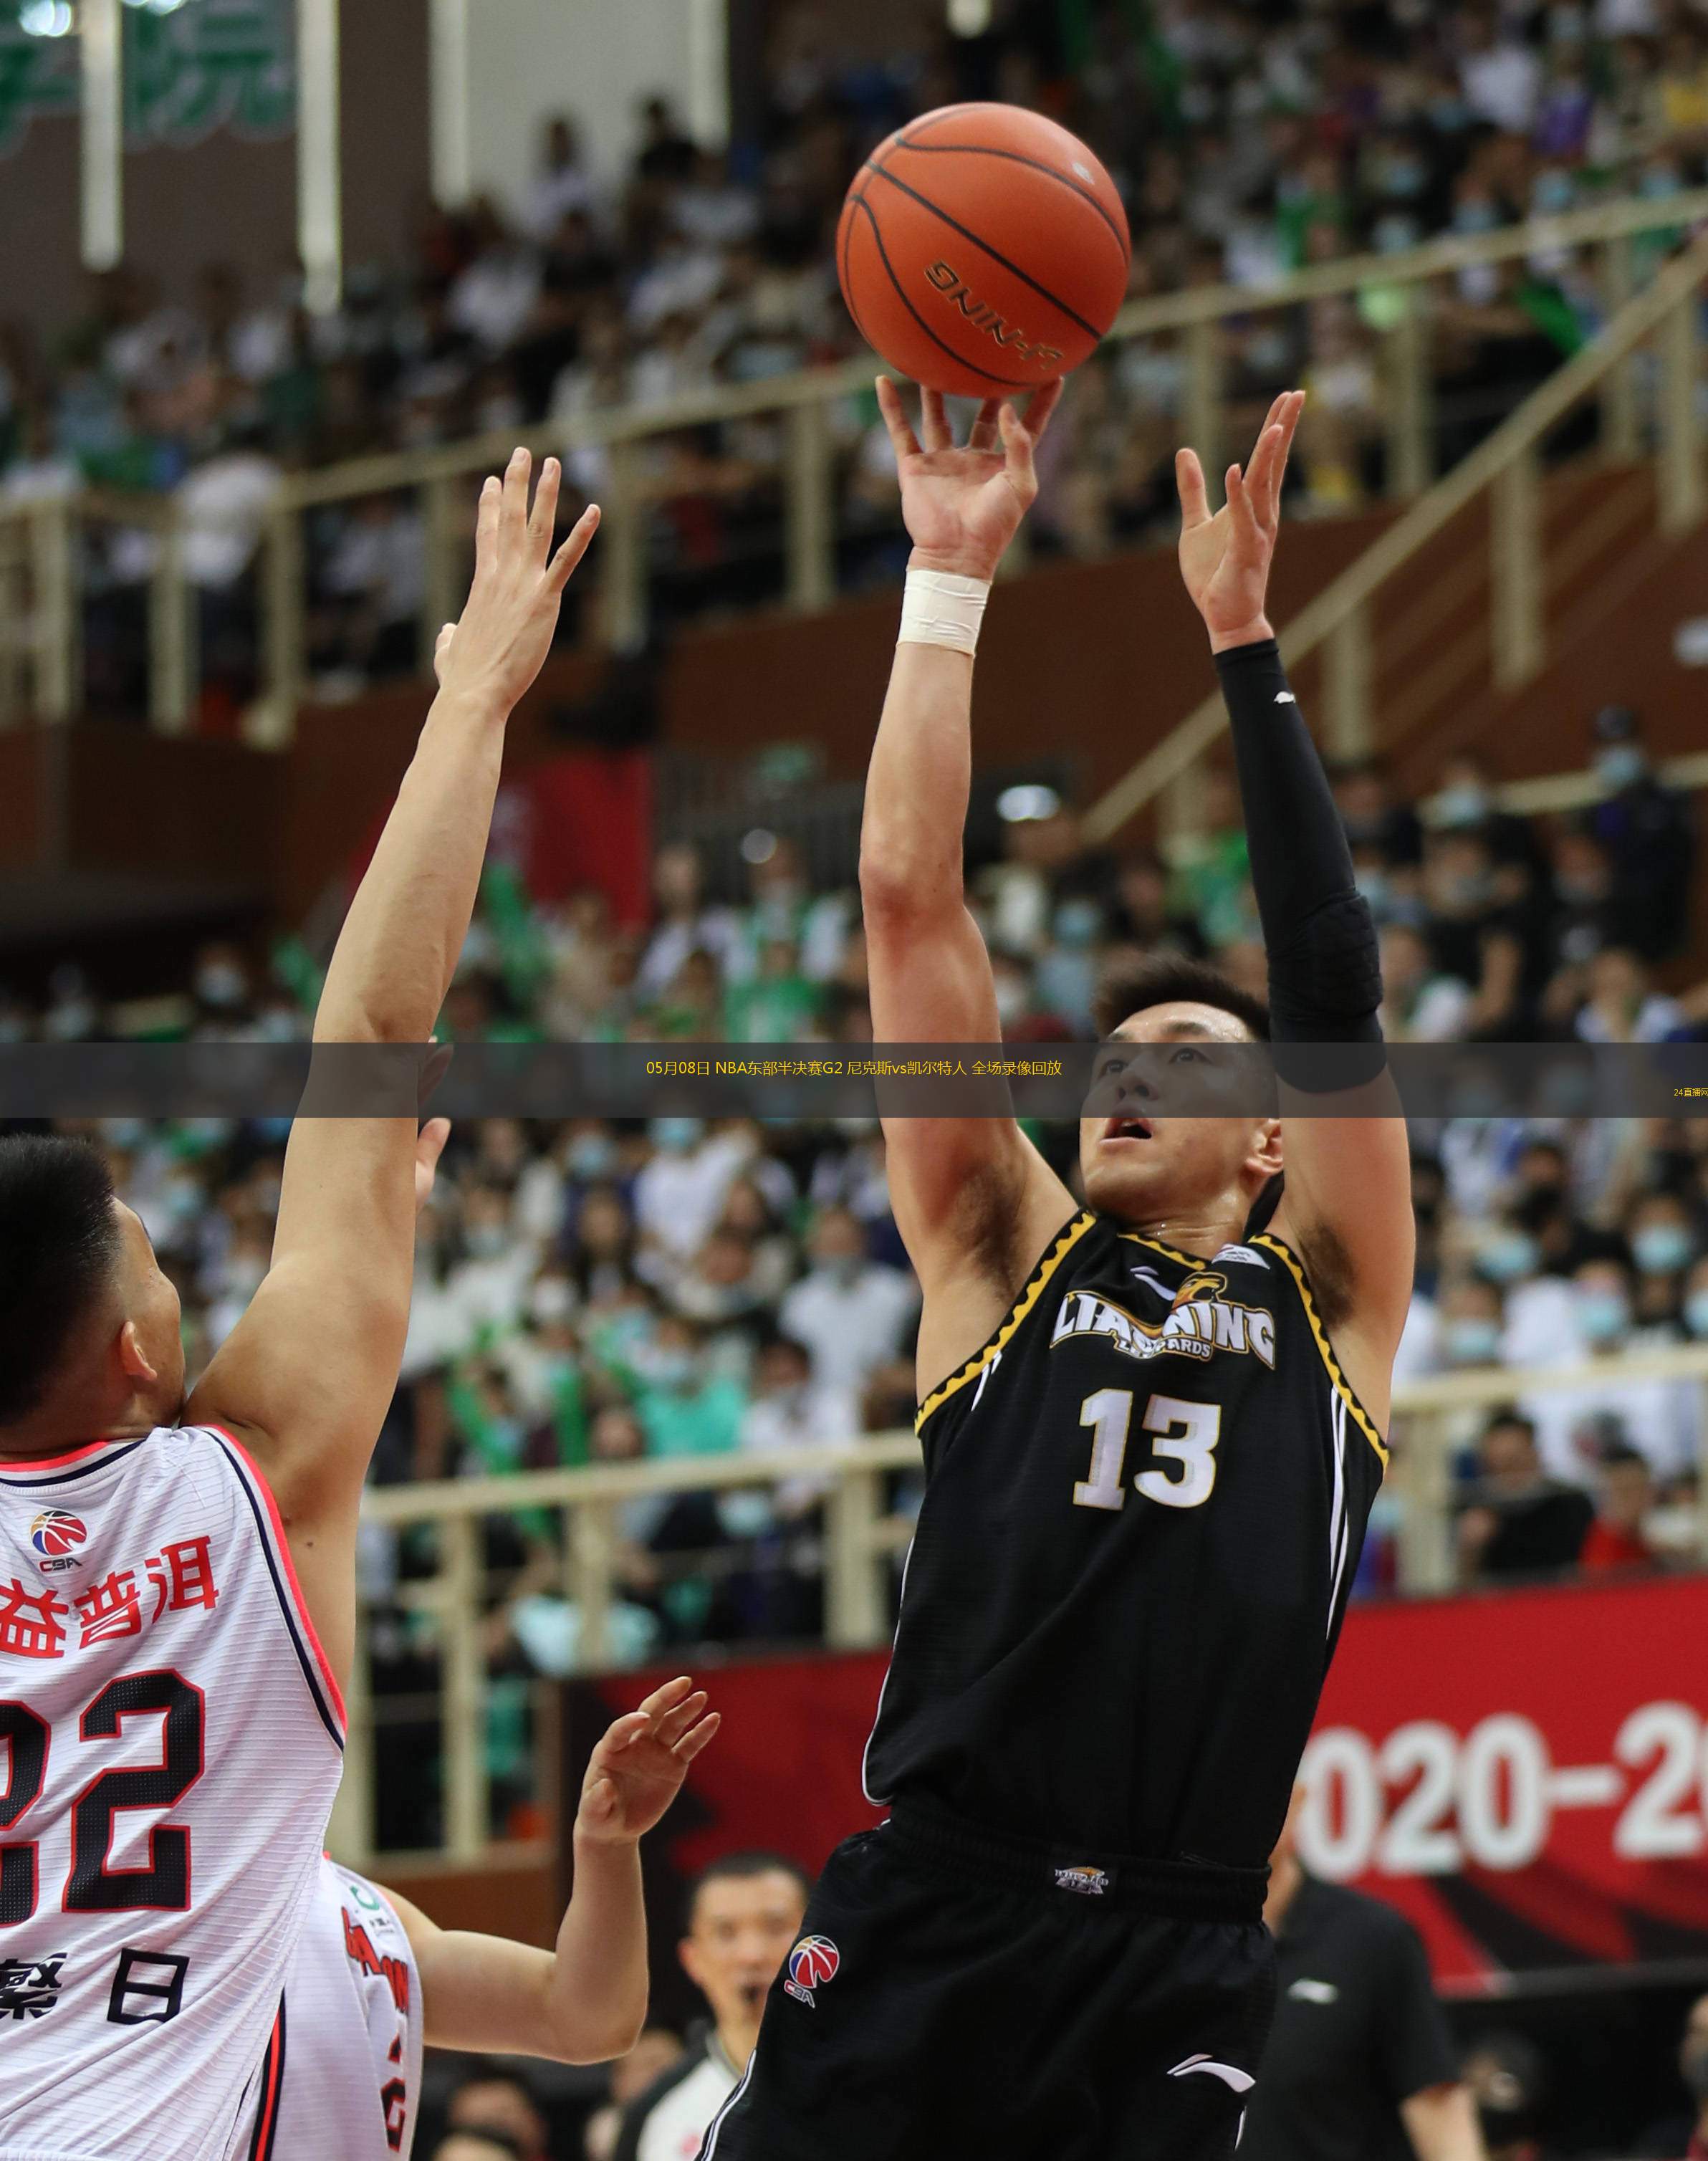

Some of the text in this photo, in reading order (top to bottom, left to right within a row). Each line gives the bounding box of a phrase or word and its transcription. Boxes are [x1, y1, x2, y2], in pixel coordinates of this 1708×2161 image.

[923, 260, 1064, 370] LI-NING
[1073, 1388, 1221, 1510] 13
[39, 1557, 82, 1573] CBA
[784, 1979, 815, 2008] CBA
